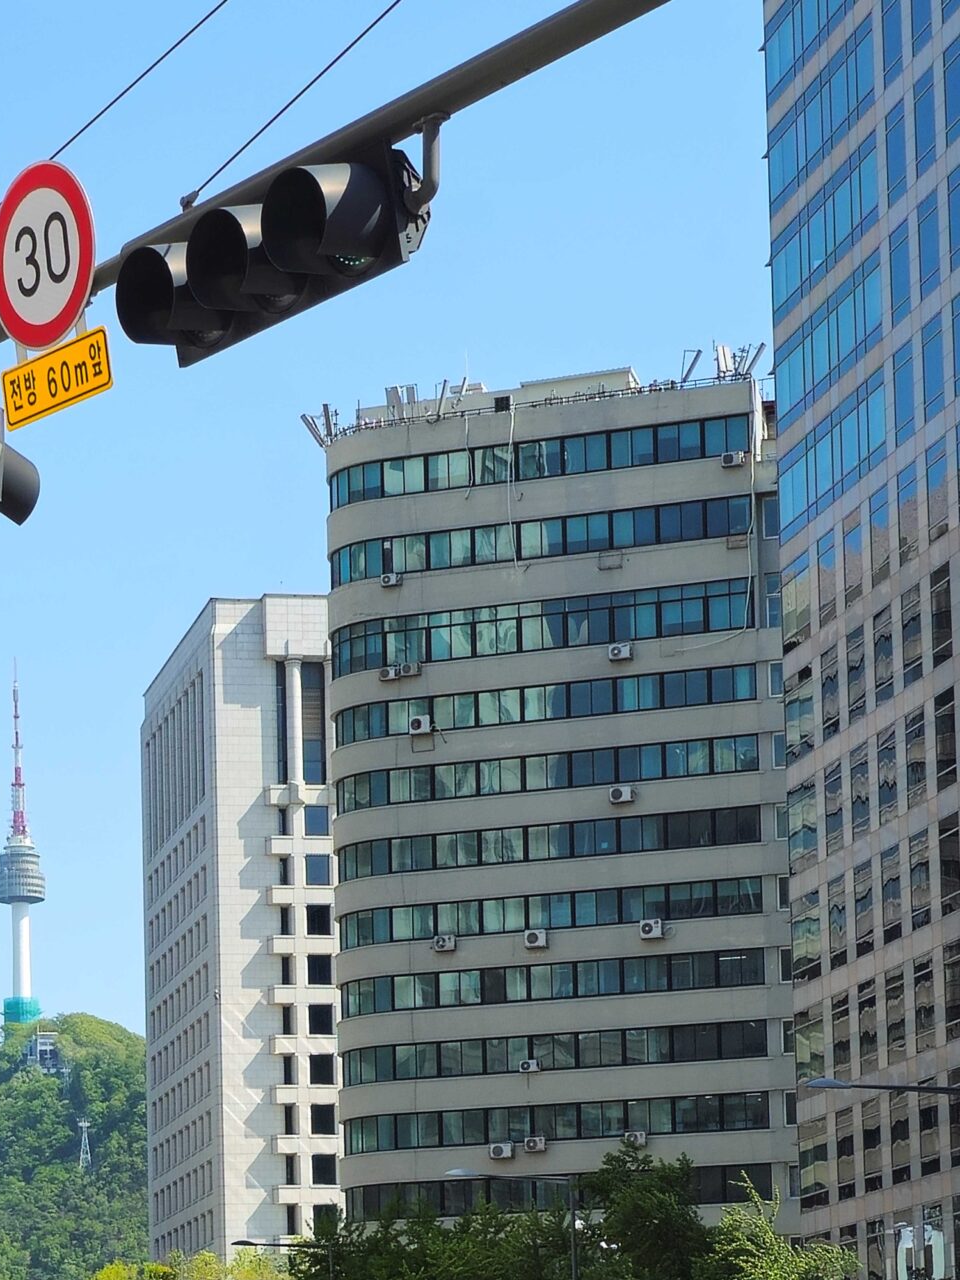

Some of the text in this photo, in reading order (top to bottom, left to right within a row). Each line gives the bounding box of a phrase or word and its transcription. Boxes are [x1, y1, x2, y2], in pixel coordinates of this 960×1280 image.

[15, 211, 71, 298] 30
[9, 339, 104, 412] 전방 60m앞
